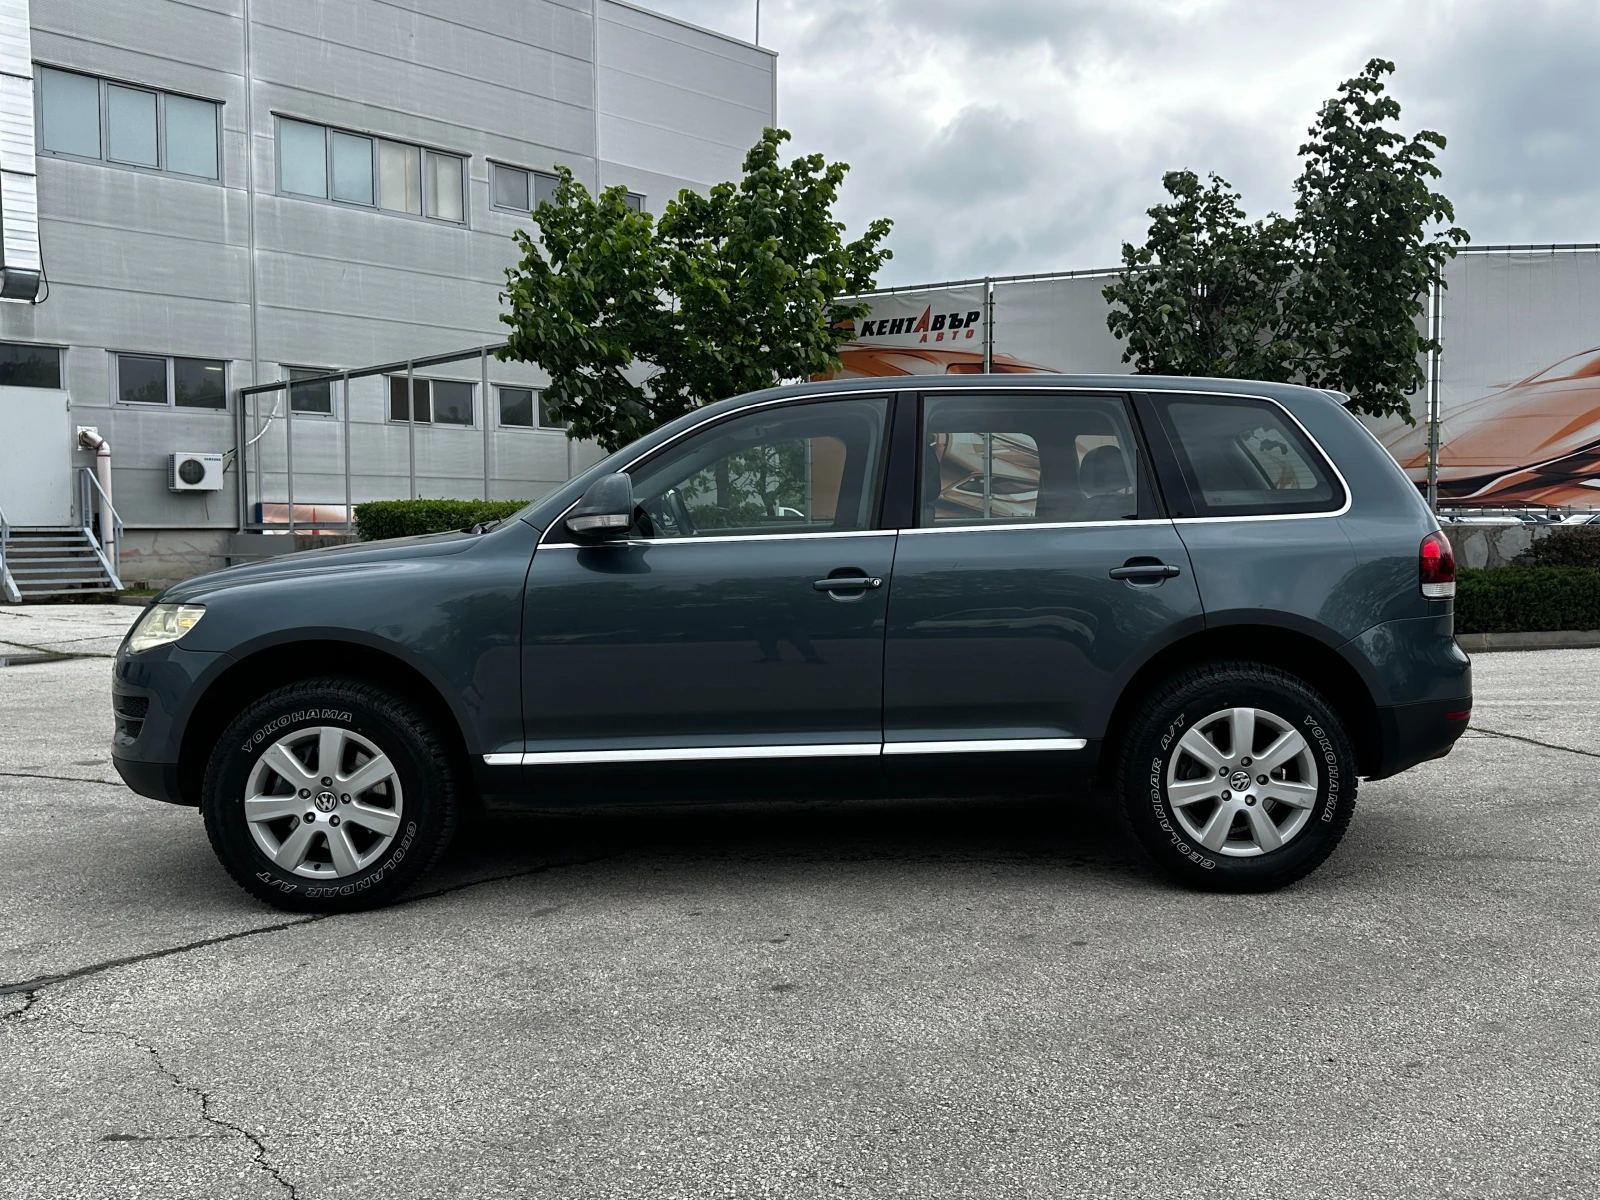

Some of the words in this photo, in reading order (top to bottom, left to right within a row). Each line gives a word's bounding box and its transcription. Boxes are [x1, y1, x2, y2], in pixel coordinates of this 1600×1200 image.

[860, 304, 981, 337] КЕНТАВЪР
[919, 329, 975, 343] АВТО
[242, 709, 353, 753] YOKOHAMA
[1160, 713, 1185, 750] A/T
[1303, 715, 1339, 822] YOKOHAMA
[1150, 757, 1216, 869] GEOLANDAR
[305, 820, 417, 898] GEOLANDAR
[256, 871, 298, 893] A/T
